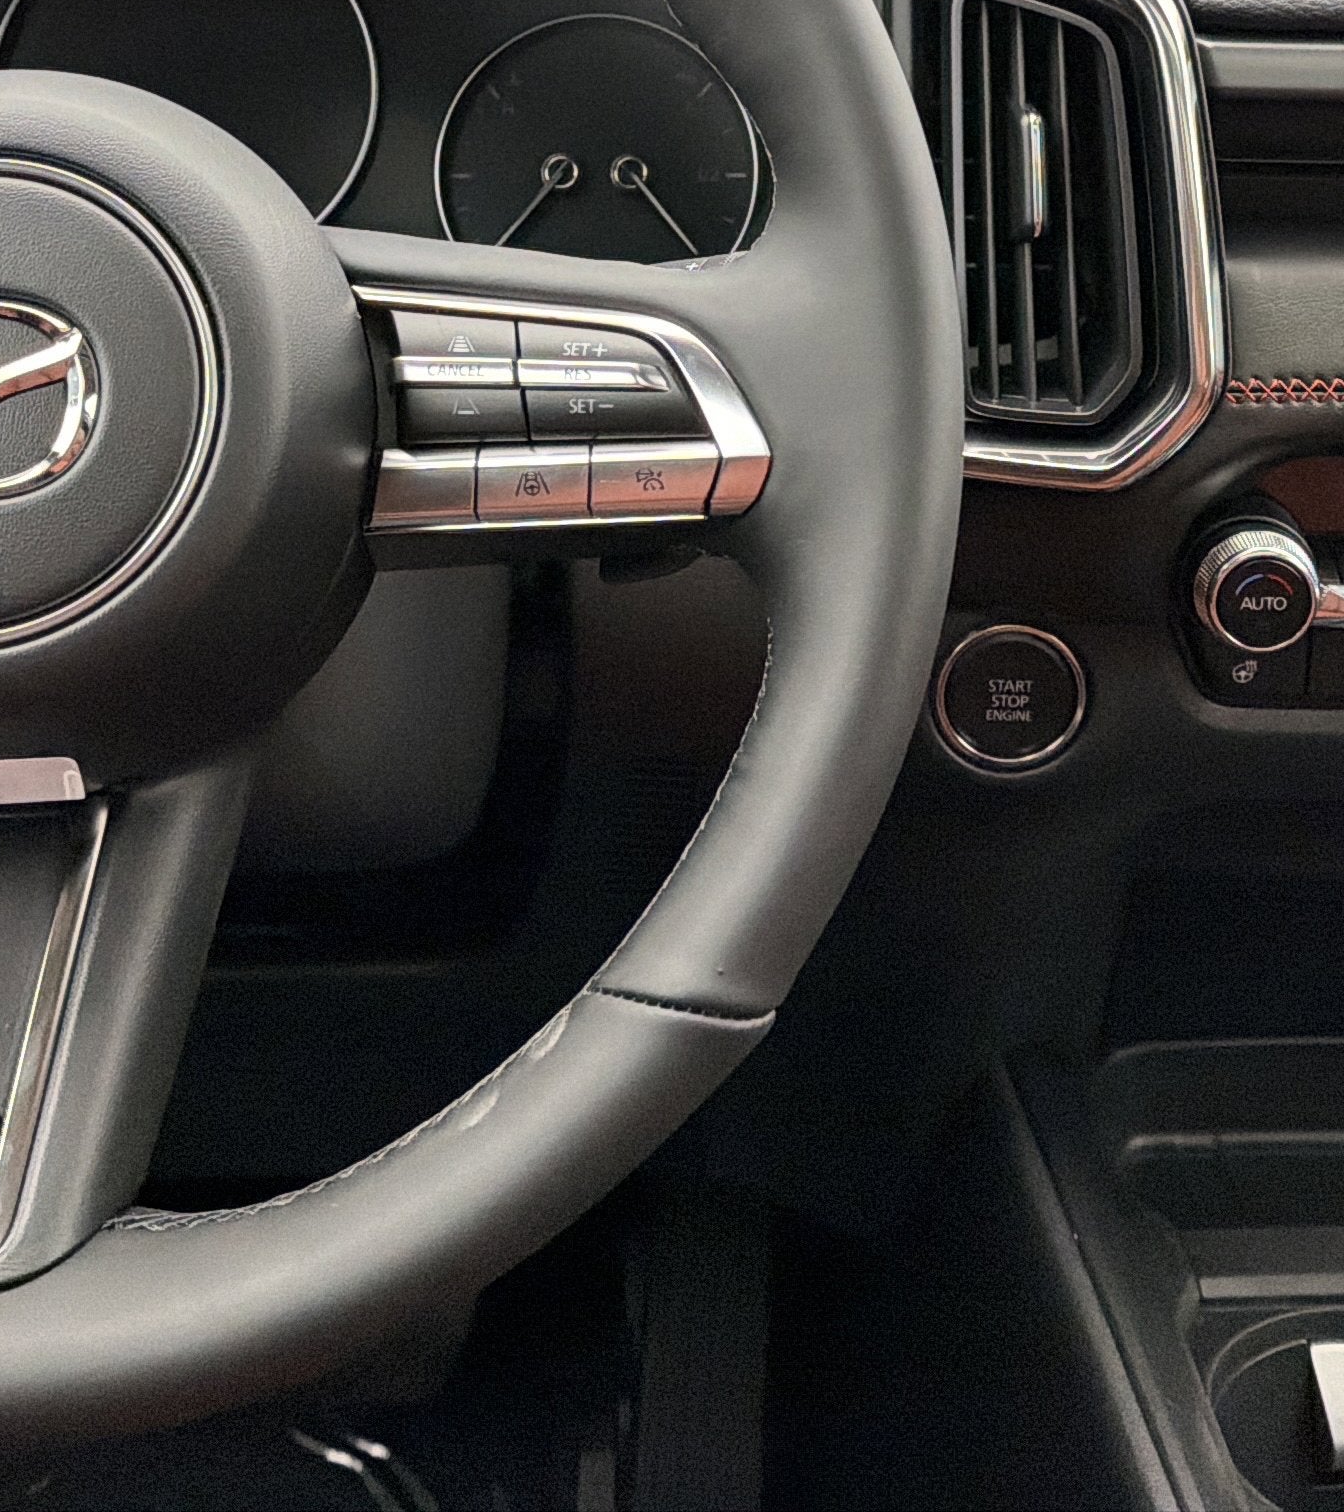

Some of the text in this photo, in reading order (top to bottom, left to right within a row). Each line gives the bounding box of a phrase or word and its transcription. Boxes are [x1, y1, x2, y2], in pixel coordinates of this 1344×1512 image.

[427, 364, 484, 378] CANCEL
[564, 367, 592, 381] RES
[1240, 595, 1288, 612] AUTO
[988, 679, 1033, 693] START
[991, 694, 1029, 709] STOP
[985, 709, 1032, 722] ENGINE
